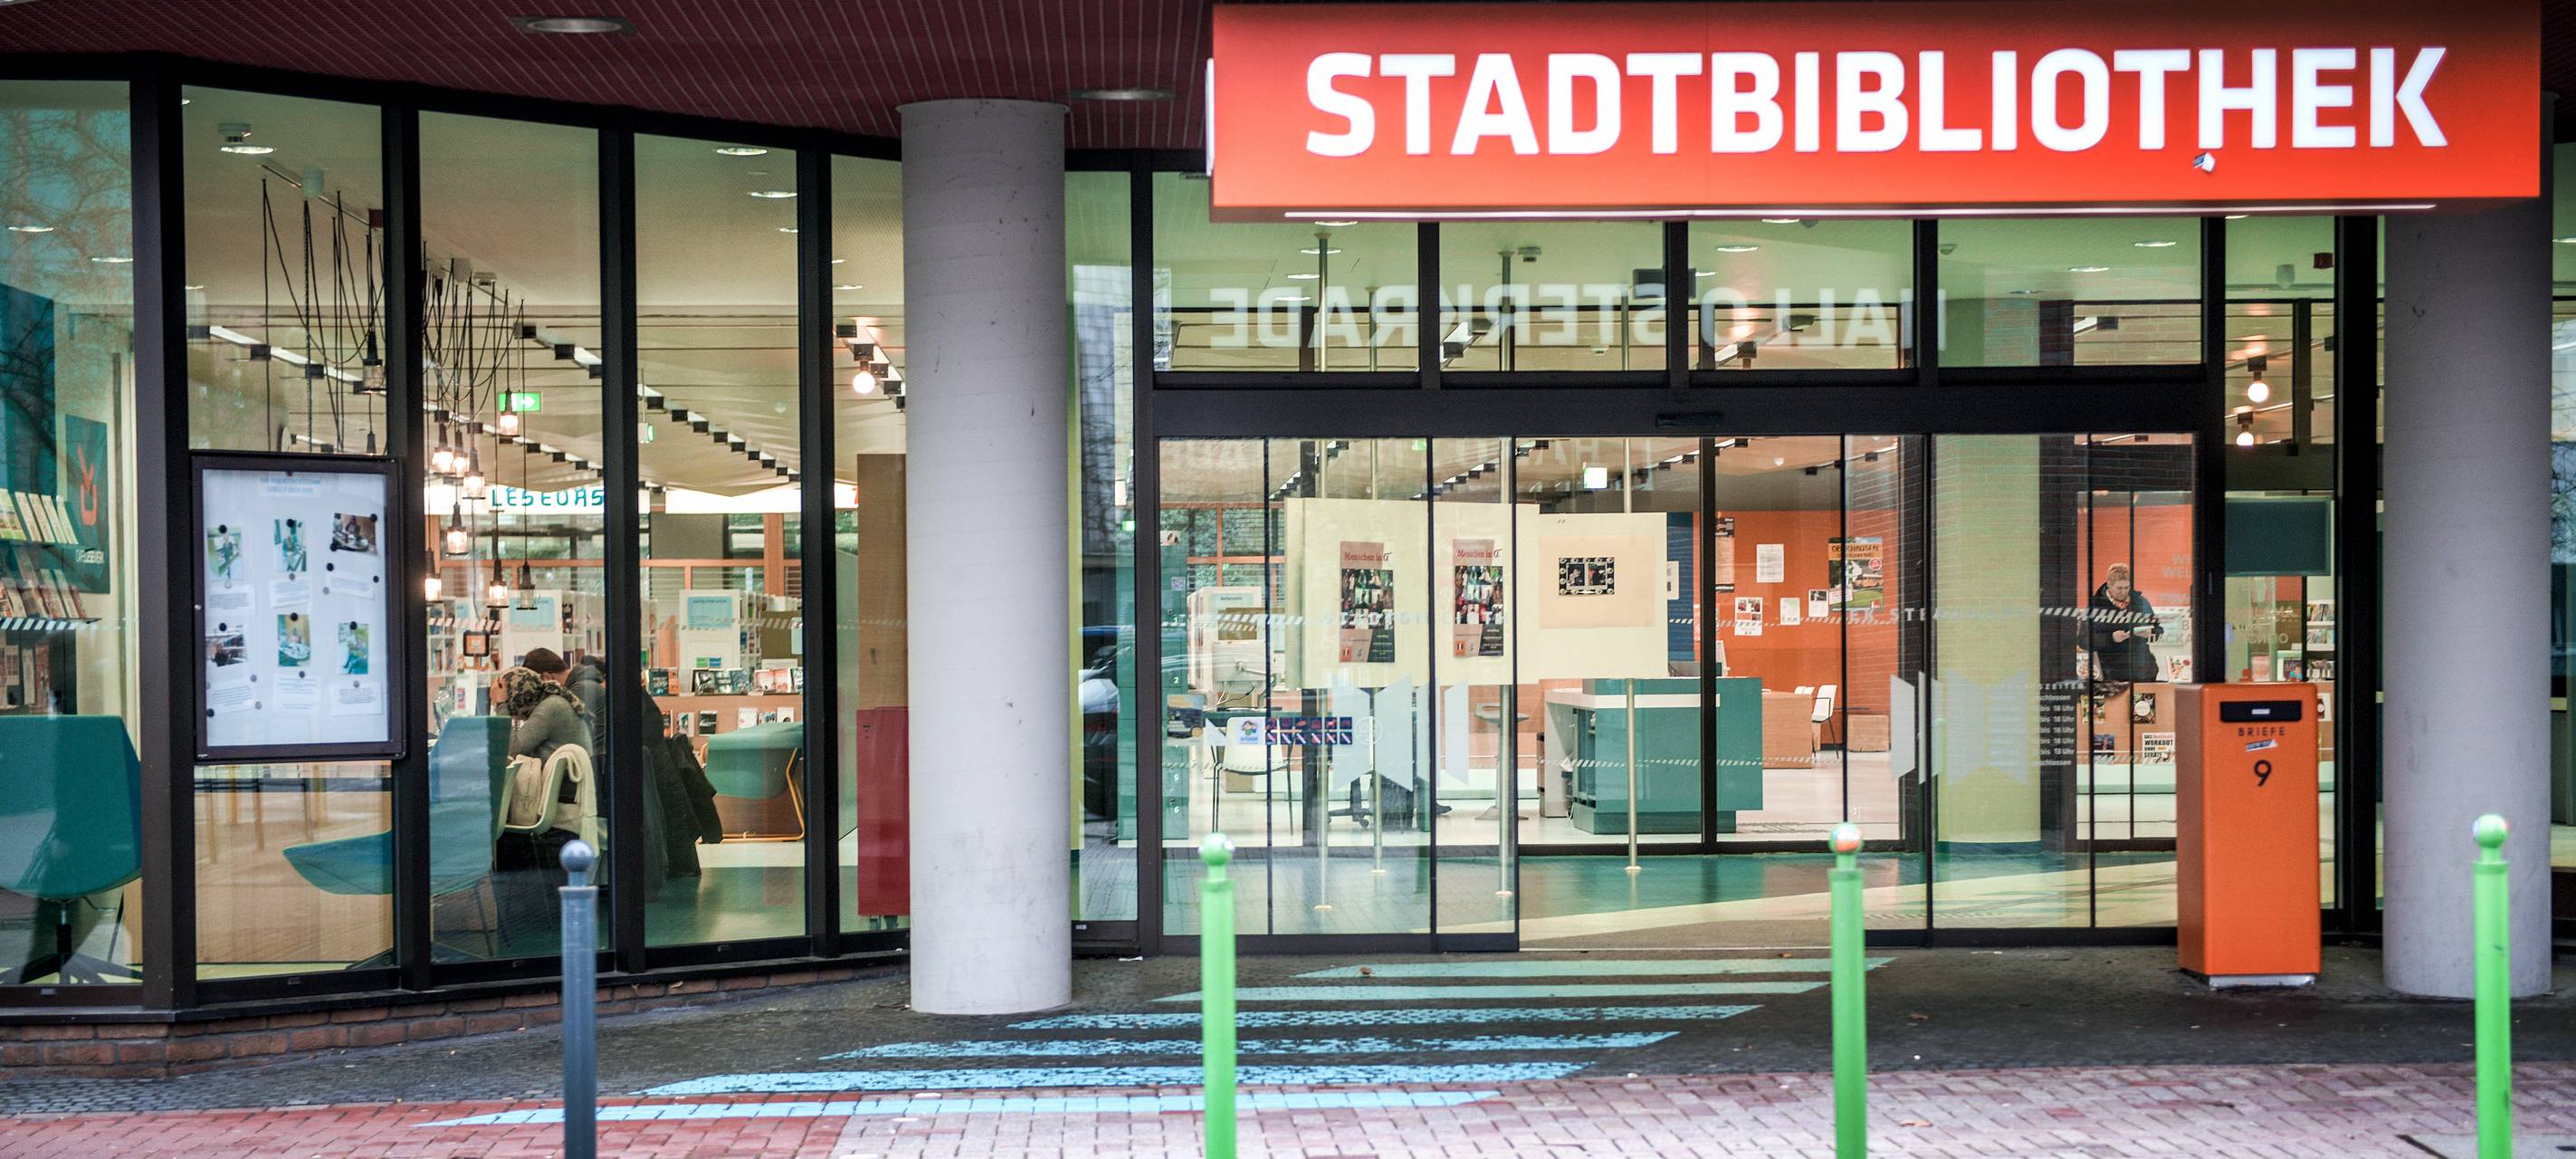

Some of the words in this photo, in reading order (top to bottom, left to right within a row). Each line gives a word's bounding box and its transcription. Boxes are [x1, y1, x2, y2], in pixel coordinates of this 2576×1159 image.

[1305, 46, 2448, 157] STADTBIBLIOTHEK
[2237, 727, 2285, 736] BRIEFE
[2254, 760, 2273, 786] 9
